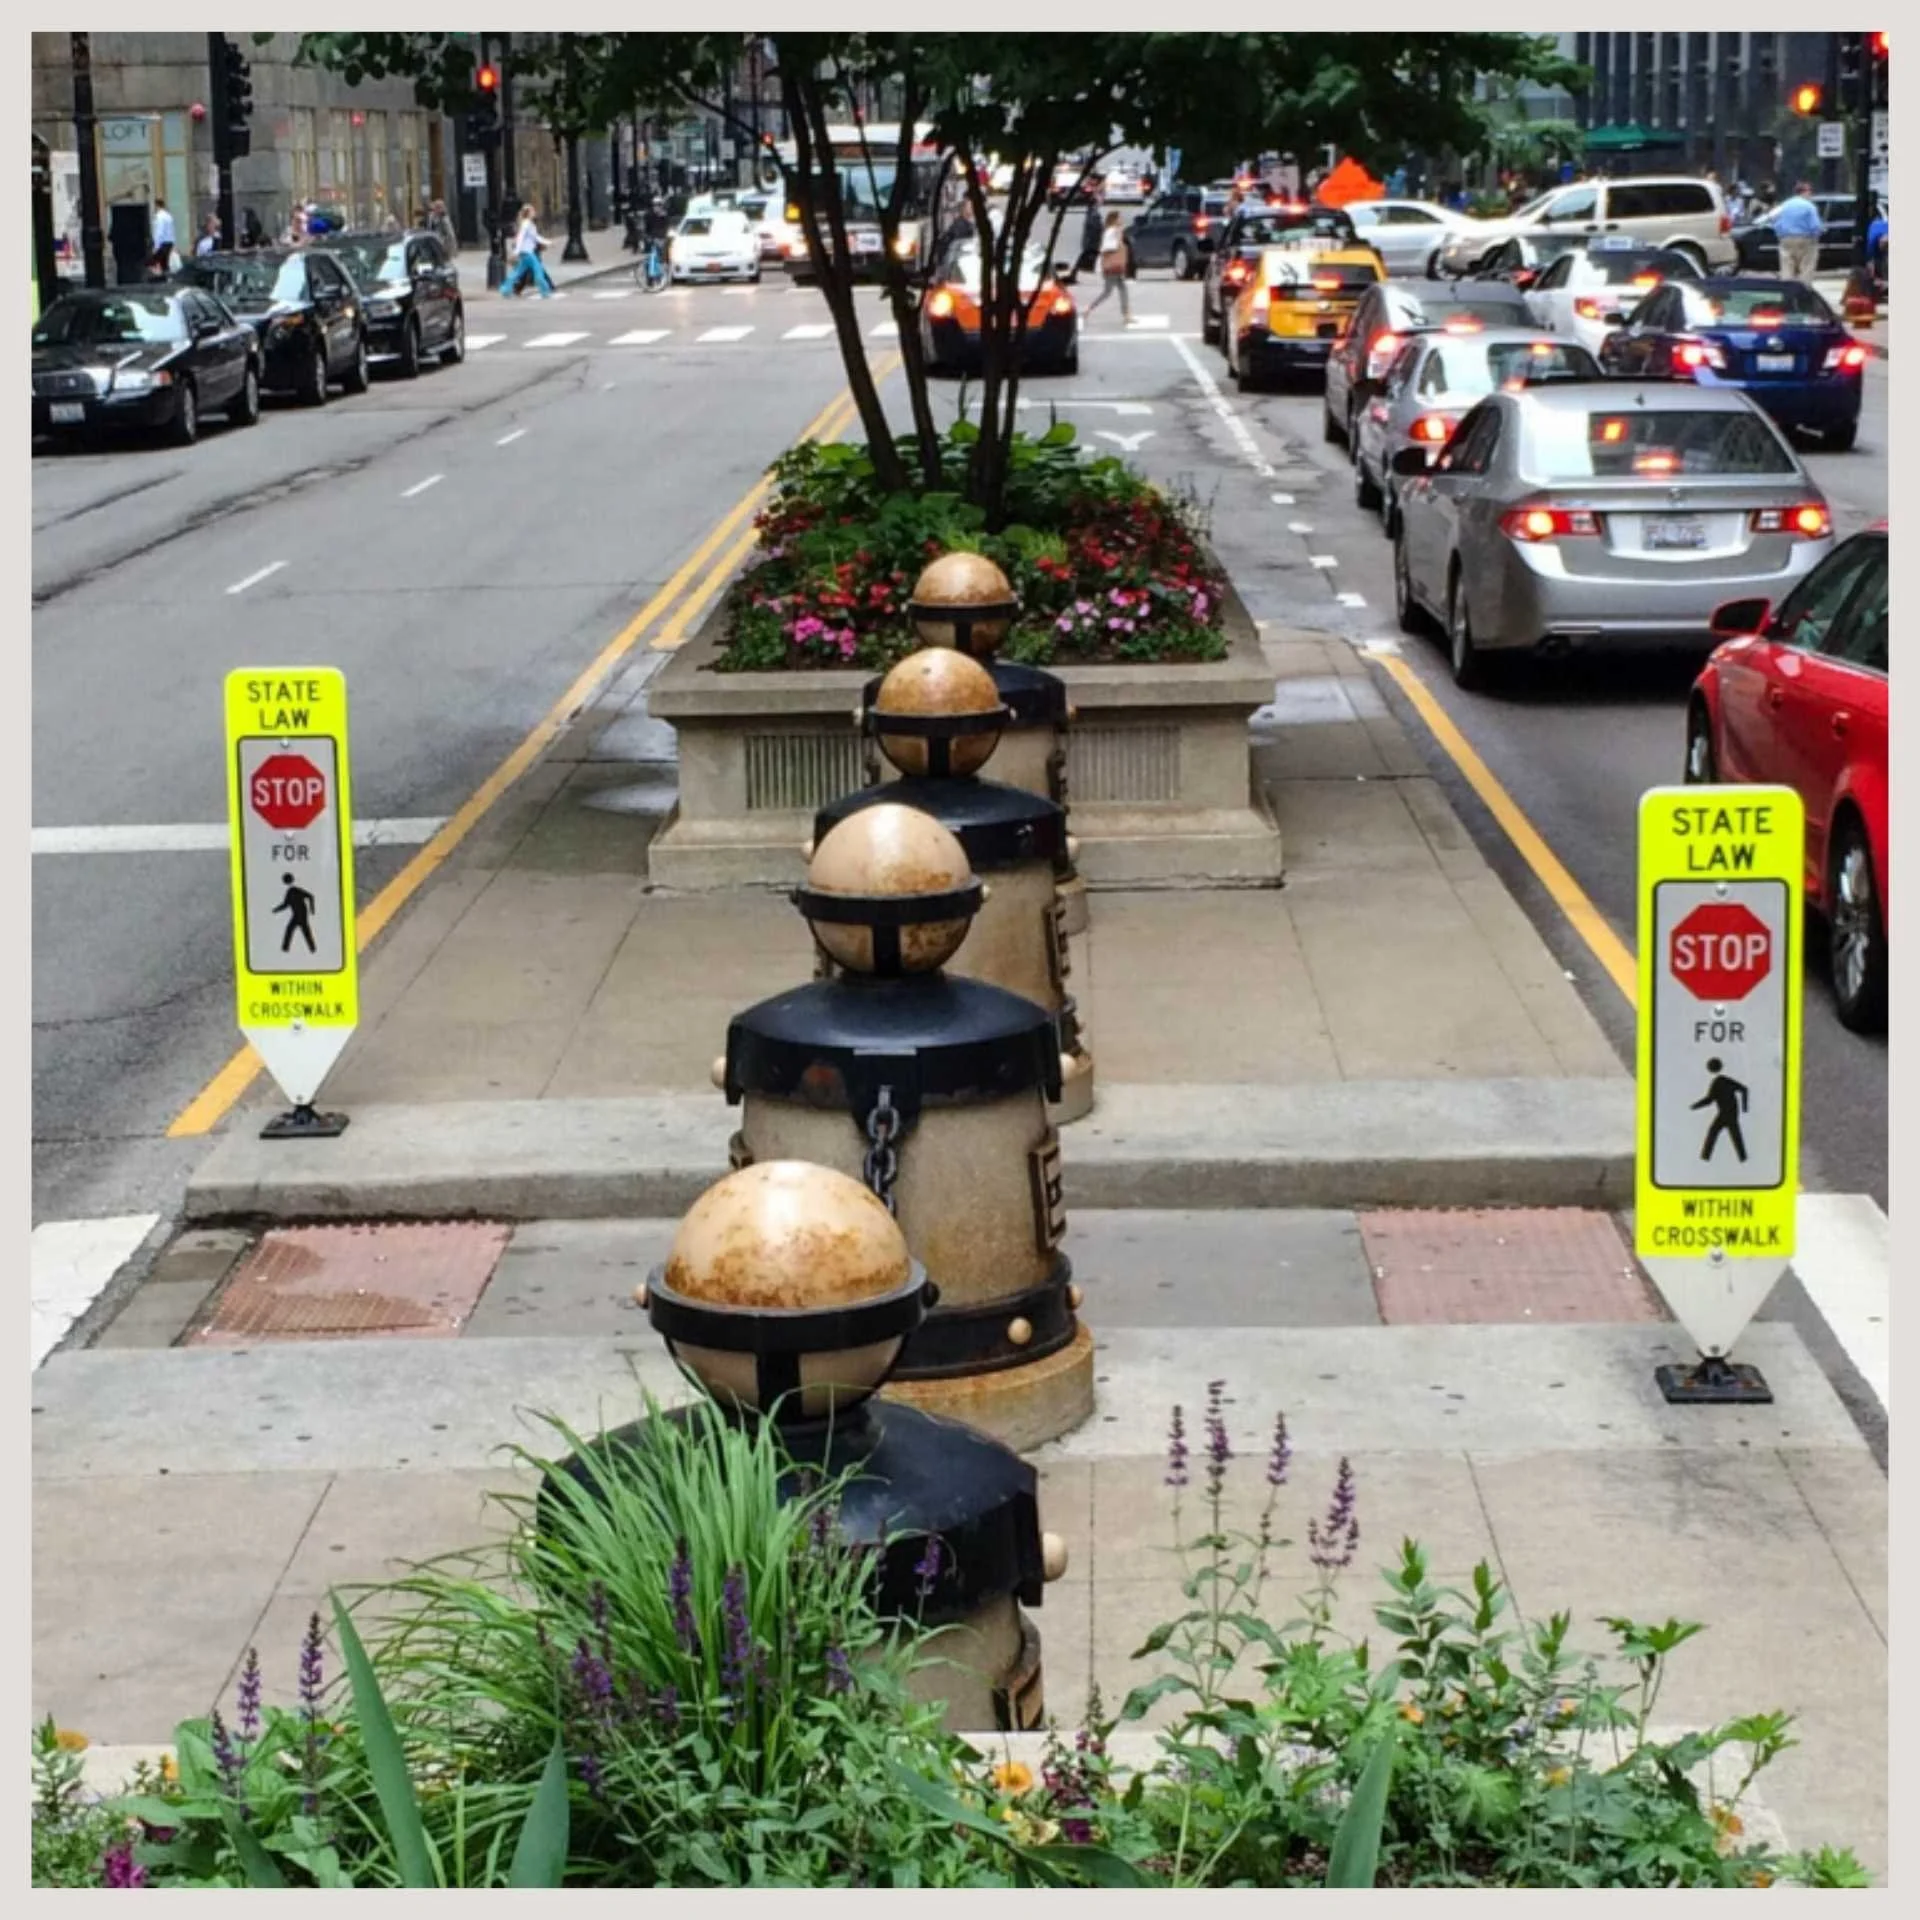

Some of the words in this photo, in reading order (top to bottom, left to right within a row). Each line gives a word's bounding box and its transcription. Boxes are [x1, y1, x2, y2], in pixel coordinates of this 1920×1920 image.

[247, 680, 321, 702] STATE
[259, 709, 310, 730] LAW
[254, 777, 323, 807] STOP
[1672, 807, 1773, 835] STATE
[271, 844, 310, 862] FOR
[1688, 844, 1756, 871] LAW
[1674, 933, 1768, 971] STOP
[270, 980, 323, 996] WITHIN
[249, 1001, 345, 1019] CROSSWALK
[1694, 1021, 1745, 1043] FOR
[1682, 1199, 1754, 1218] WITHIN
[1652, 1226, 1780, 1248] CROSSWALK
